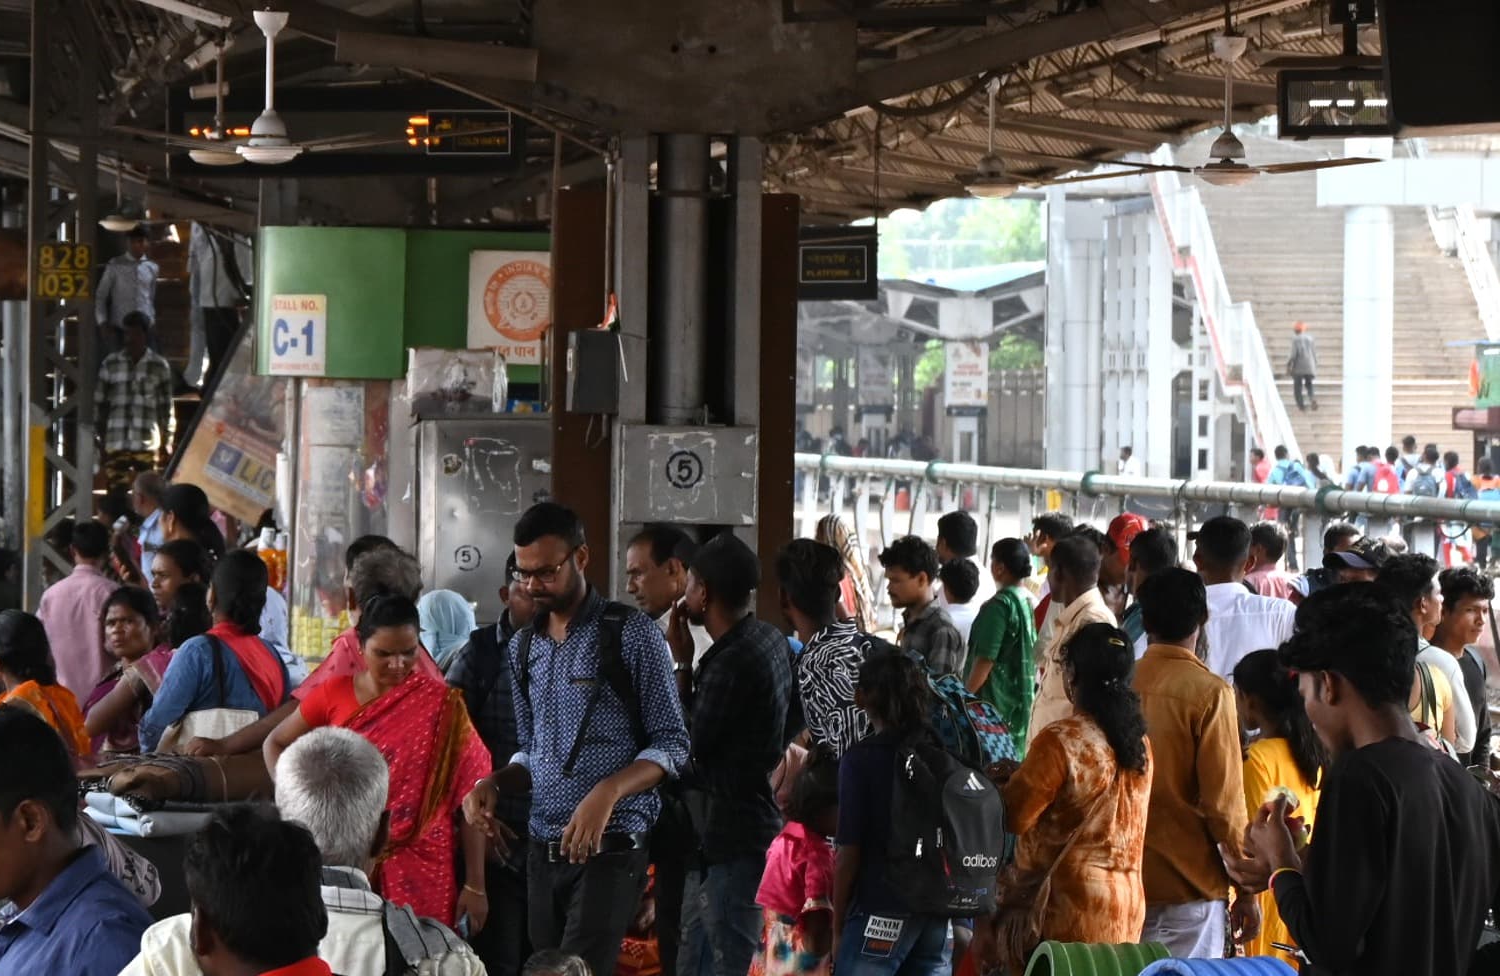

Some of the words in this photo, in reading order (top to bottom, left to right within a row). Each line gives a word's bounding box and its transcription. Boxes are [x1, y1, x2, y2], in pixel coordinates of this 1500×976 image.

[39, 245, 90, 269] 828
[37, 273, 90, 298] 1032
[274, 299, 297, 311] STALL
[301, 299, 319, 311] NO.
[273, 318, 315, 357] C-1
[238, 457, 276, 491] LIC
[677, 459, 693, 483] 5
[459, 550, 472, 563] 5
[866, 927, 900, 940] PISTOLS
[870, 917, 902, 930] DENIM
